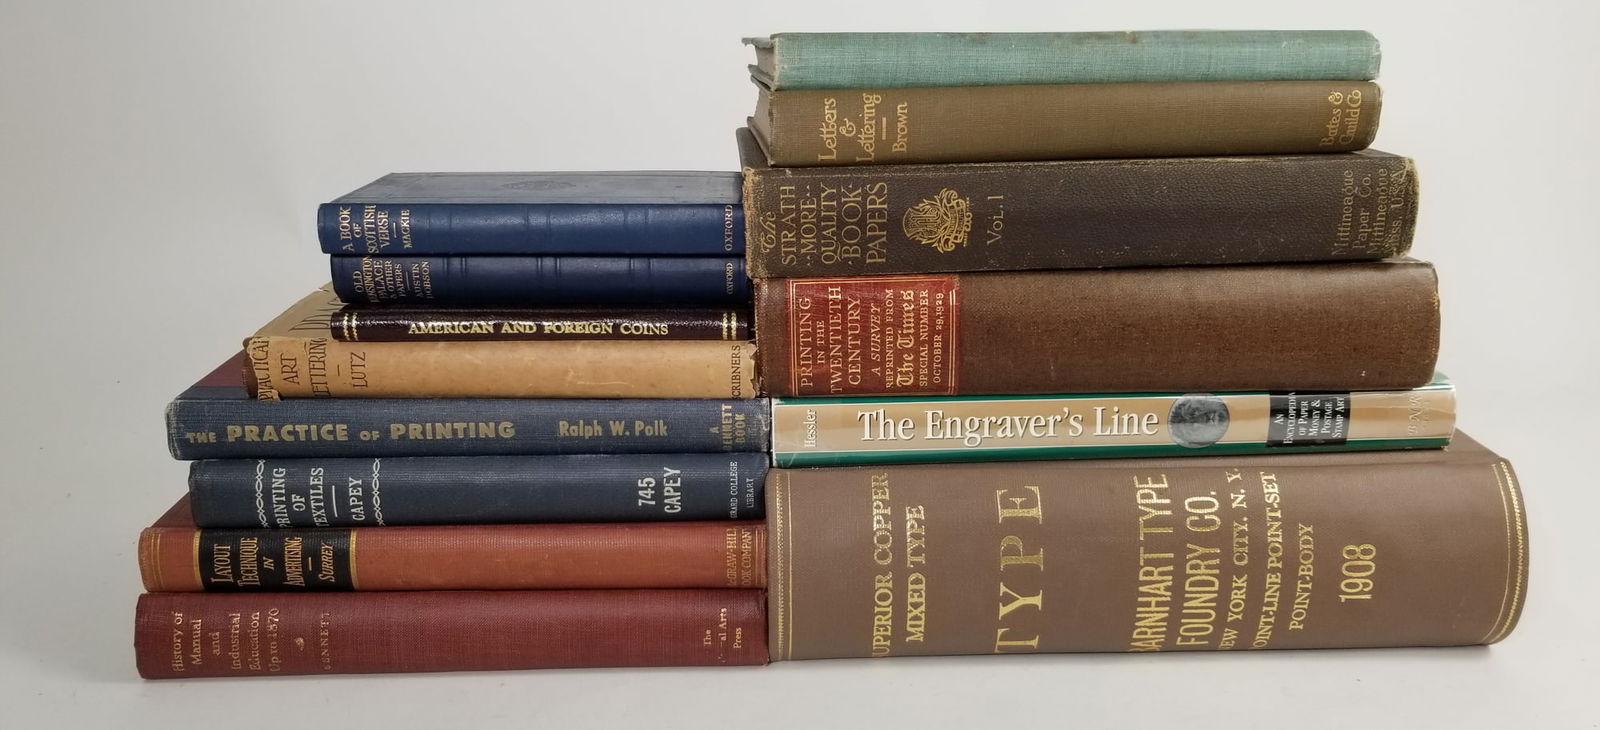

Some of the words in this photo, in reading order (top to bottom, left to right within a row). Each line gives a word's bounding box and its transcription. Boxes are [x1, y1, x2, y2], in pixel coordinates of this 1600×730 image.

[1328, 91, 1344, 105] &
[818, 97, 837, 161] Letters
[839, 118, 856, 137] &
[856, 93, 882, 163] Lettering
[892, 102, 908, 153] Brown
[1319, 107, 1342, 147] Bates
[1358, 173, 1372, 197] Co.
[339, 206, 352, 240] BOOK
[353, 223, 362, 238] OF
[363, 204, 379, 254] SCOTTISH
[377, 211, 391, 248] VERSE
[400, 209, 412, 249] MACKIE
[724, 204, 733, 251] OXFORD
[760, 211, 777, 252] The
[779, 185, 797, 265] STRATH
[821, 182, 841, 264] QUALITY
[866, 182, 888, 264] PAPERS
[1352, 207, 1372, 249] Paper
[342, 242, 354, 252] A
[353, 271, 364, 292] OLD
[384, 260, 395, 292] OTHER
[885, 288, 894, 322] FROM
[897, 290, 914, 350] Times
[919, 289, 929, 343] NUMBER
[408, 321, 494, 335] AMERICAN
[501, 321, 537, 335] AND
[543, 321, 614, 335] FOREIGN
[620, 322, 669, 335] COINS
[799, 296, 812, 388] PRINTING
[816, 320, 825, 345] THE
[828, 286, 843, 394] TWENTIETH
[848, 296, 861, 385] CENTURY
[870, 303, 881, 361] SURVEY
[280, 352, 300, 385] ART
[350, 351, 368, 388] LUTZ
[816, 350, 825, 364] IN
[871, 367, 880, 376] A
[885, 326, 894, 389] REPRINTED
[896, 353, 914, 388] The
[919, 345, 928, 387] SPECIAL
[933, 334, 942, 384] OCTOBER
[1311, 399, 1321, 407] &
[187, 431, 217, 443] THE
[227, 423, 349, 442] PRACTICE
[360, 430, 380, 441] OF
[390, 421, 515, 440] PRINTING
[558, 419, 602, 439] Ralph
[609, 420, 630, 436] W.
[635, 420, 668, 436] Polk
[709, 426, 719, 434] A
[804, 409, 818, 448] Hessler
[858, 408, 915, 442] The
[925, 406, 1084, 448] Engraver's
[1093, 404, 1160, 439] Line
[349, 477, 365, 521] CAPEY
[638, 477, 656, 507] 745
[663, 467, 681, 513] CAPEY
[730, 461, 738, 496] COLLEGE
[1231, 488, 1248, 508] N.
[292, 494, 306, 512] OF
[871, 472, 893, 566] COPPER
[1133, 474, 1174, 541] TYPE
[1185, 491, 1221, 533] CO.
[1260, 472, 1284, 569] POINT-SET
[906, 504, 926, 568] TYPE
[1233, 516, 1249, 566] CITY.
[210, 544, 234, 583] LAYOUT
[237, 537, 261, 587] TECHNIQUE
[262, 557, 275, 570] IN
[283, 537, 306, 587] ADVERTISING
[318, 543, 335, 582] SURREY
[1289, 523, 1314, 631] POINT-BODY
[1338, 543, 1377, 603] 1908
[906, 572, 926, 643] MIXED
[1176, 544, 1221, 646] FOUNDRY
[1227, 573, 1248, 623] YORK
[719, 608, 727, 630] Arts
[733, 627, 742, 649] Press
[172, 628, 184, 672] History
[190, 619, 202, 665] Manual
[209, 631, 220, 656] and
